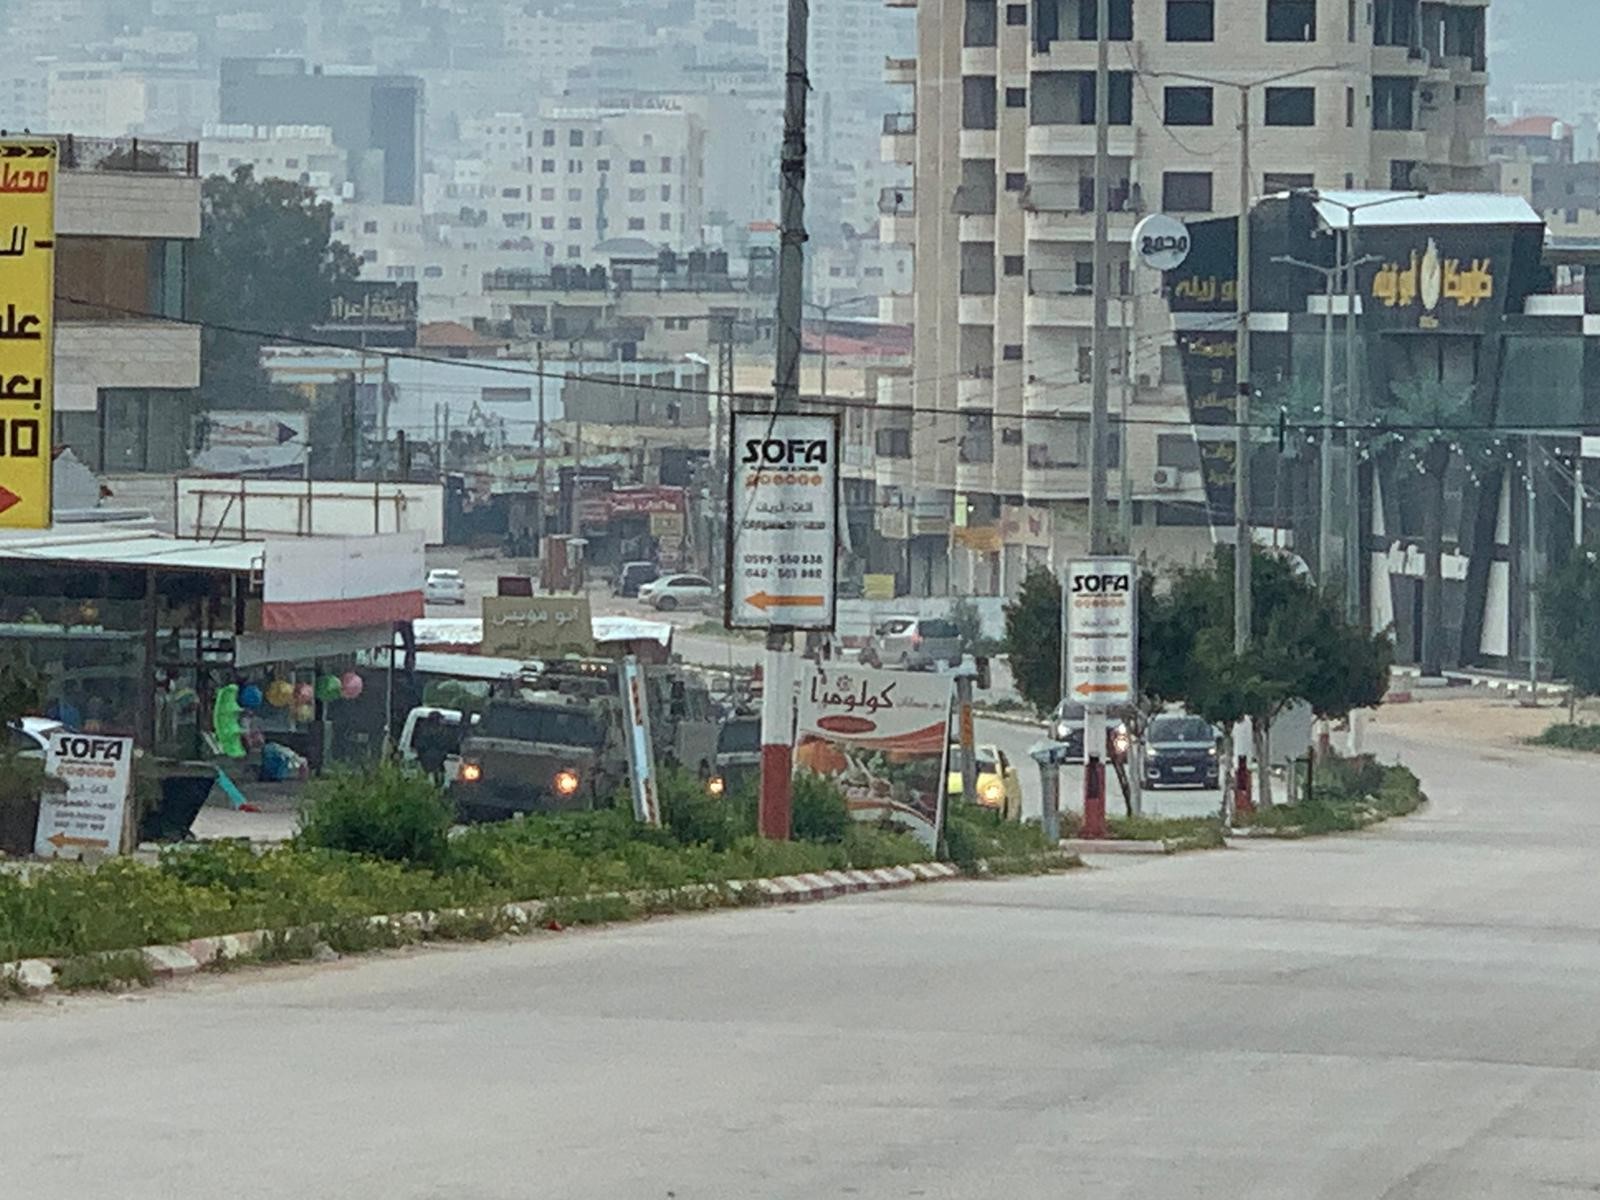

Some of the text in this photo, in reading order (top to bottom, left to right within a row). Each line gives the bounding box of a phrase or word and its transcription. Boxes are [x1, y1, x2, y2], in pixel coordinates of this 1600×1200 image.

[1142, 236, 1188, 255] مجمع
[742, 439, 828, 464] SOFA
[1072, 574, 1129, 592] SOFA
[56, 737, 123, 760] SOFA
